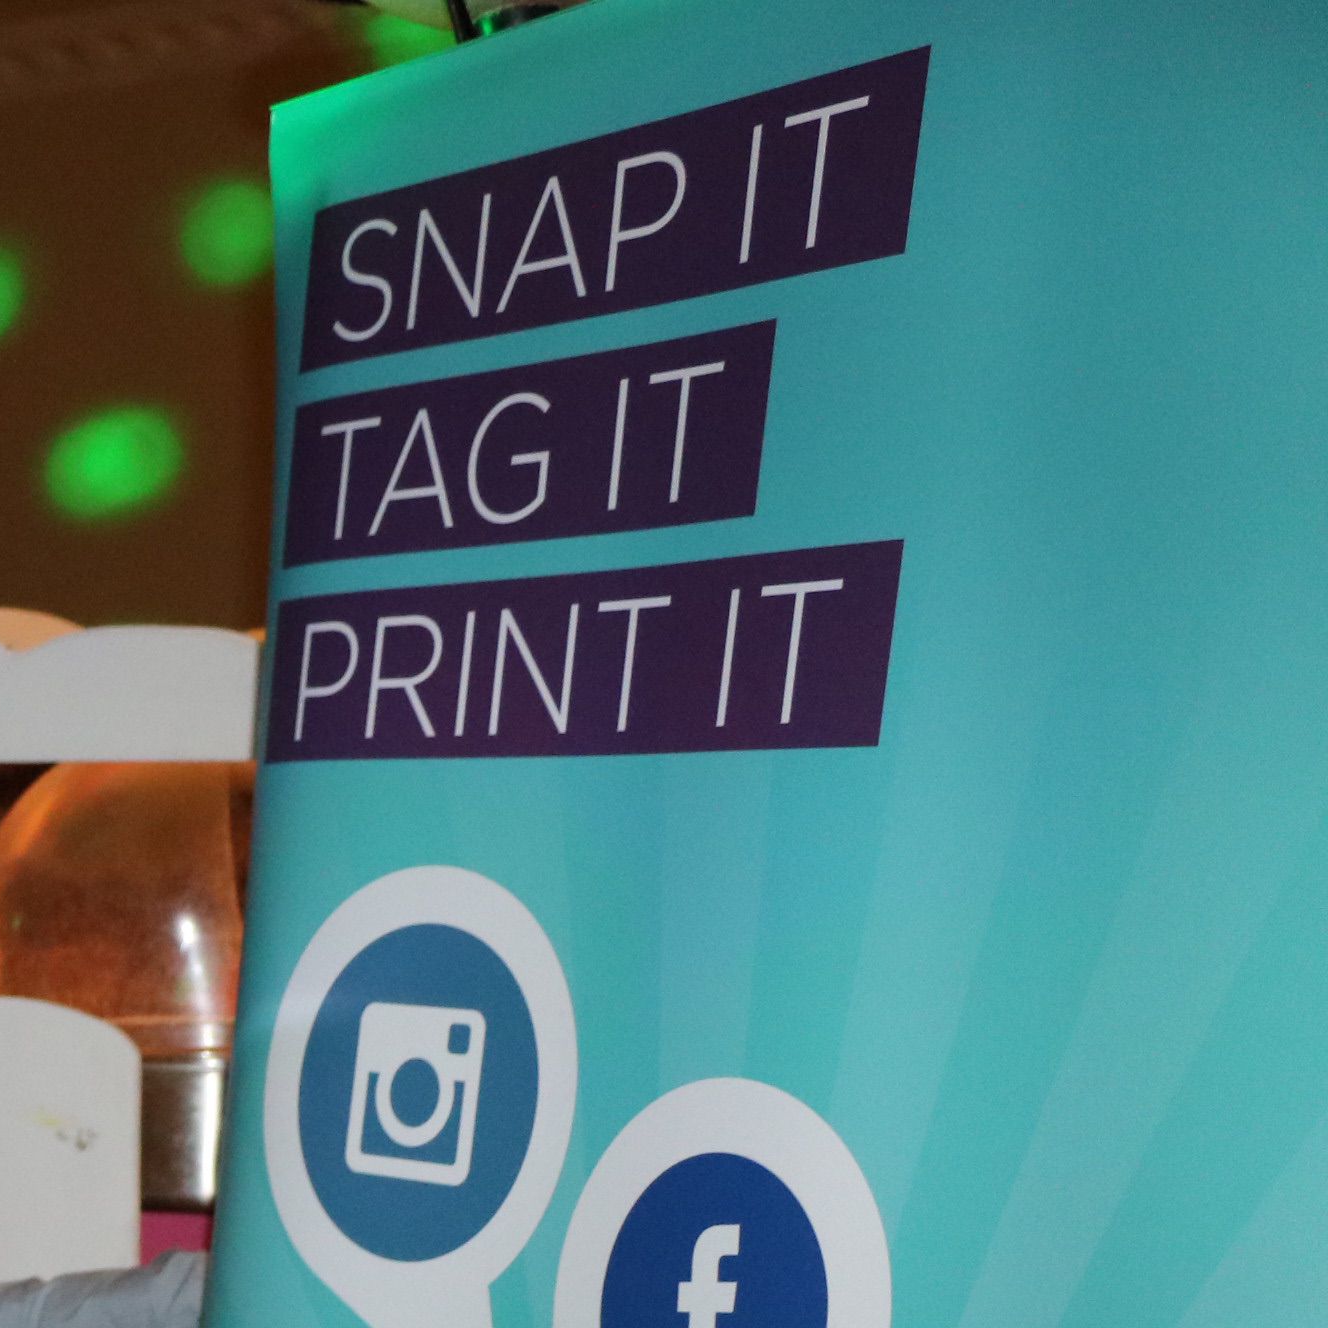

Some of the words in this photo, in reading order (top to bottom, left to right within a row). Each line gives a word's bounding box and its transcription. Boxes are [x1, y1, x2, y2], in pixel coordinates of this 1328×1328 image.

[332, 150, 688, 343] SNAP
[738, 94, 871, 264] IT
[320, 391, 552, 541] TAG
[606, 360, 726, 511] IT
[293, 595, 672, 743] PRINT
[715, 578, 844, 728] IT
